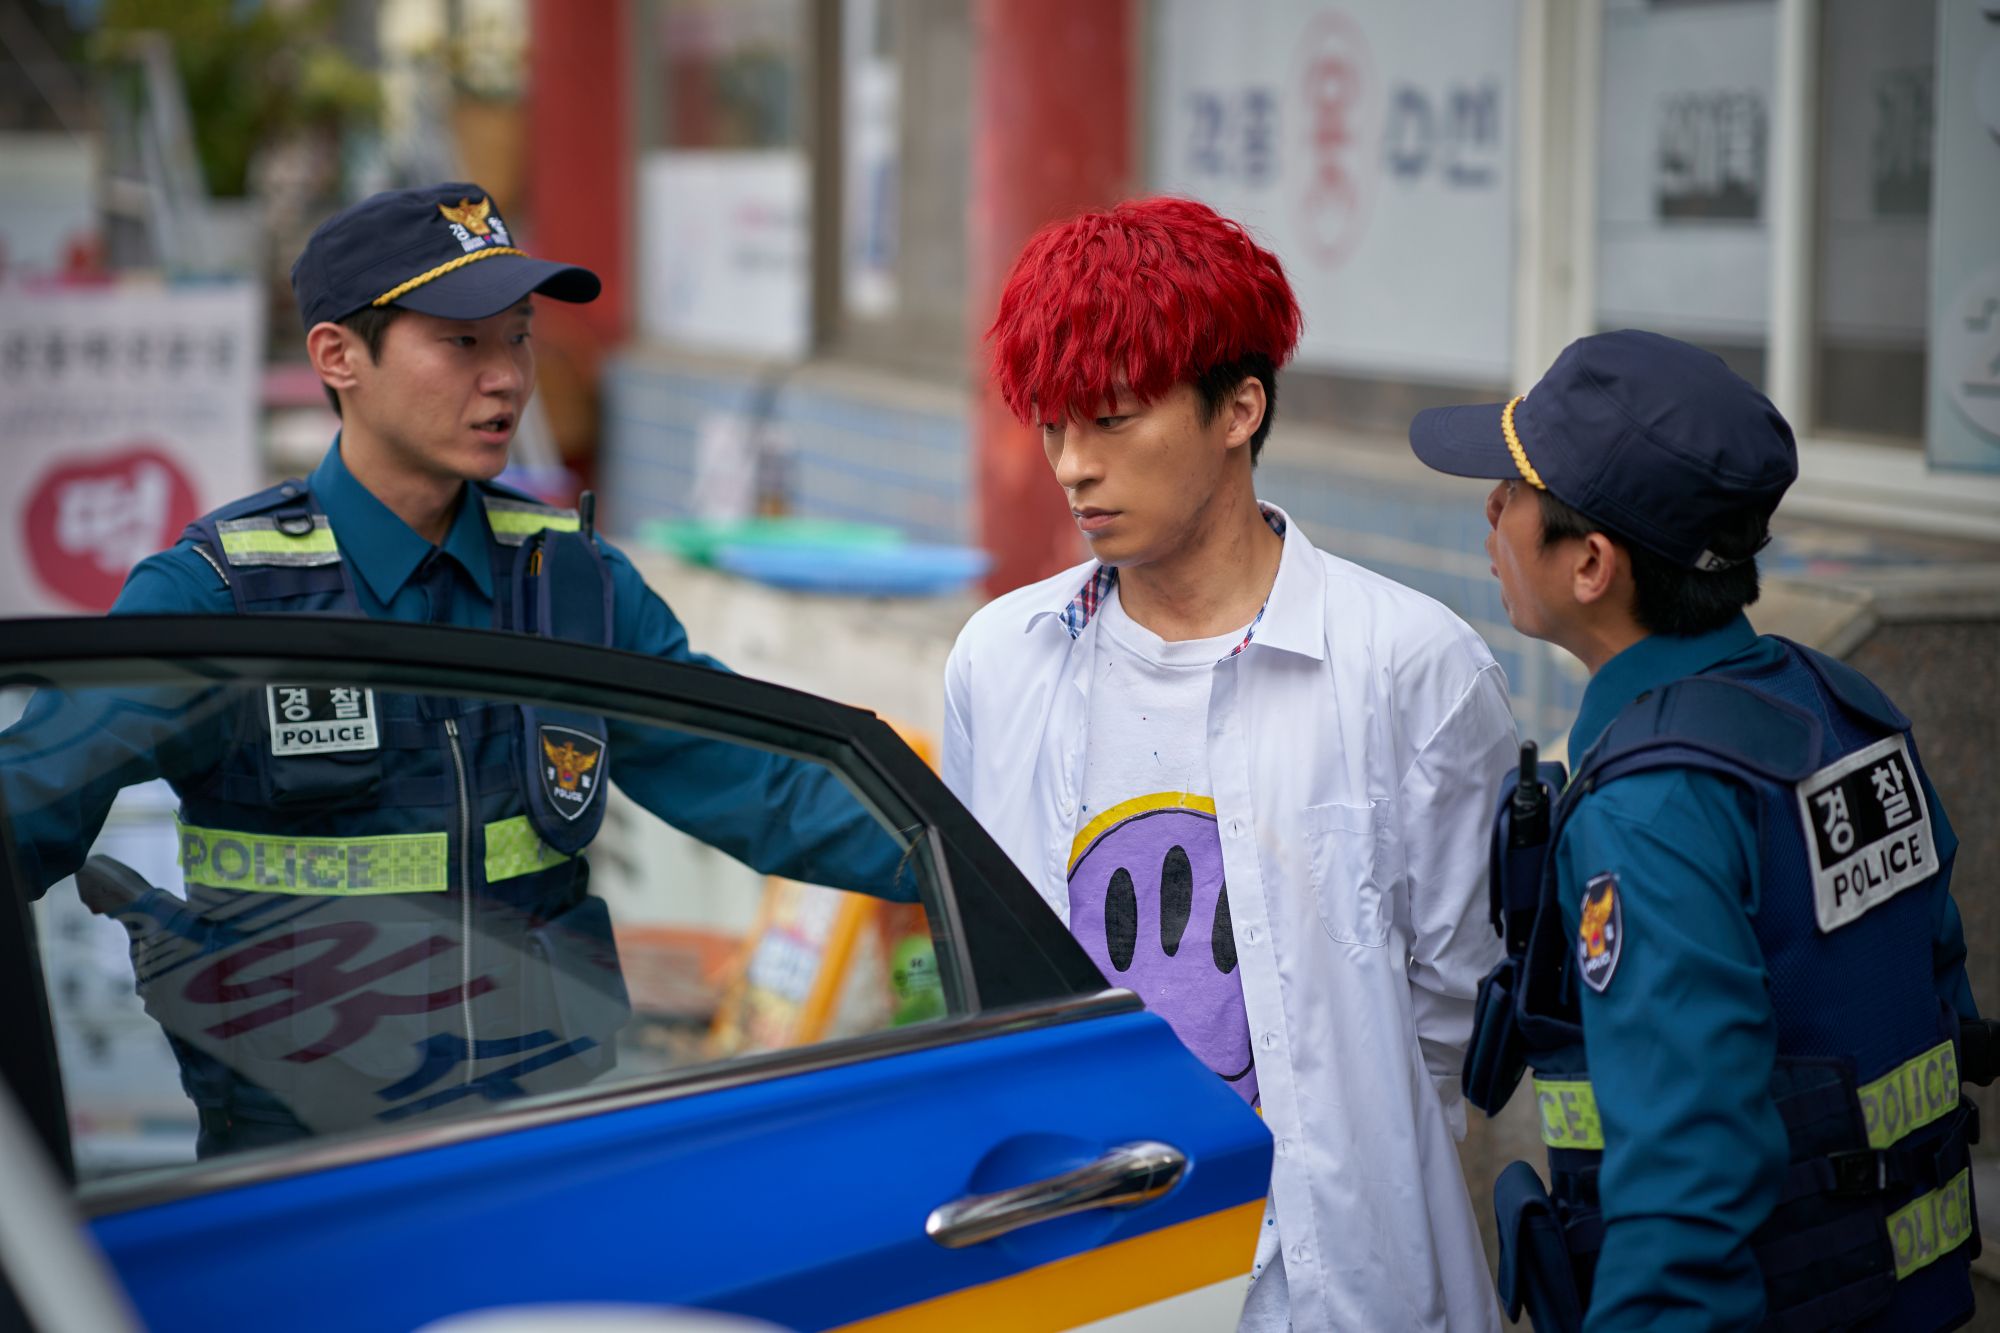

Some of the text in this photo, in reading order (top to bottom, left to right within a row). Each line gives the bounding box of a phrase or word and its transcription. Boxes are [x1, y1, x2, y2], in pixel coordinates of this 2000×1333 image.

[283, 726, 366, 746] POLICE
[182, 832, 376, 889] POLICE
[1833, 833, 1922, 908] POLICE
[1860, 1051, 1958, 1134] POLICE
